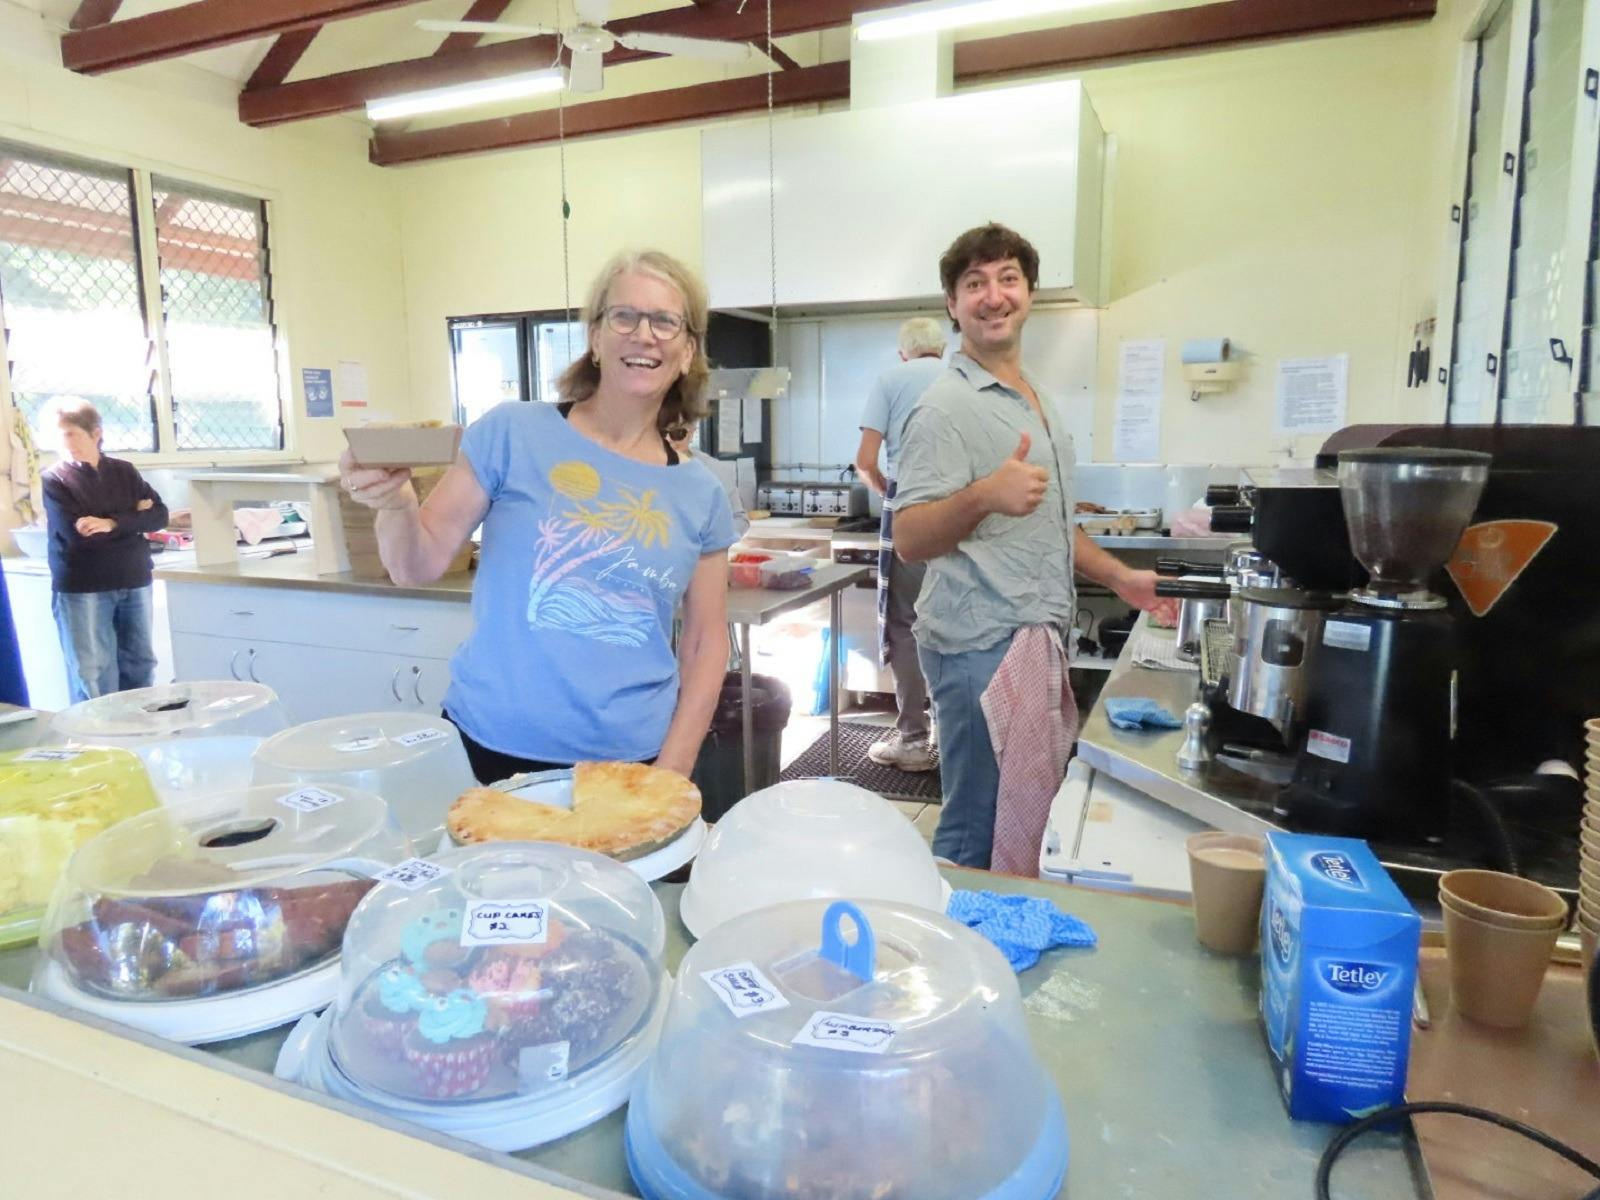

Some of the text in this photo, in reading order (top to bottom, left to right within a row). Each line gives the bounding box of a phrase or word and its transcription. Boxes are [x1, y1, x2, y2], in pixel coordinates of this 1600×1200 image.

[1322, 856, 1353, 883] Tetley
[476, 911, 501, 919] CUP
[1328, 964, 1389, 990] Tetley
